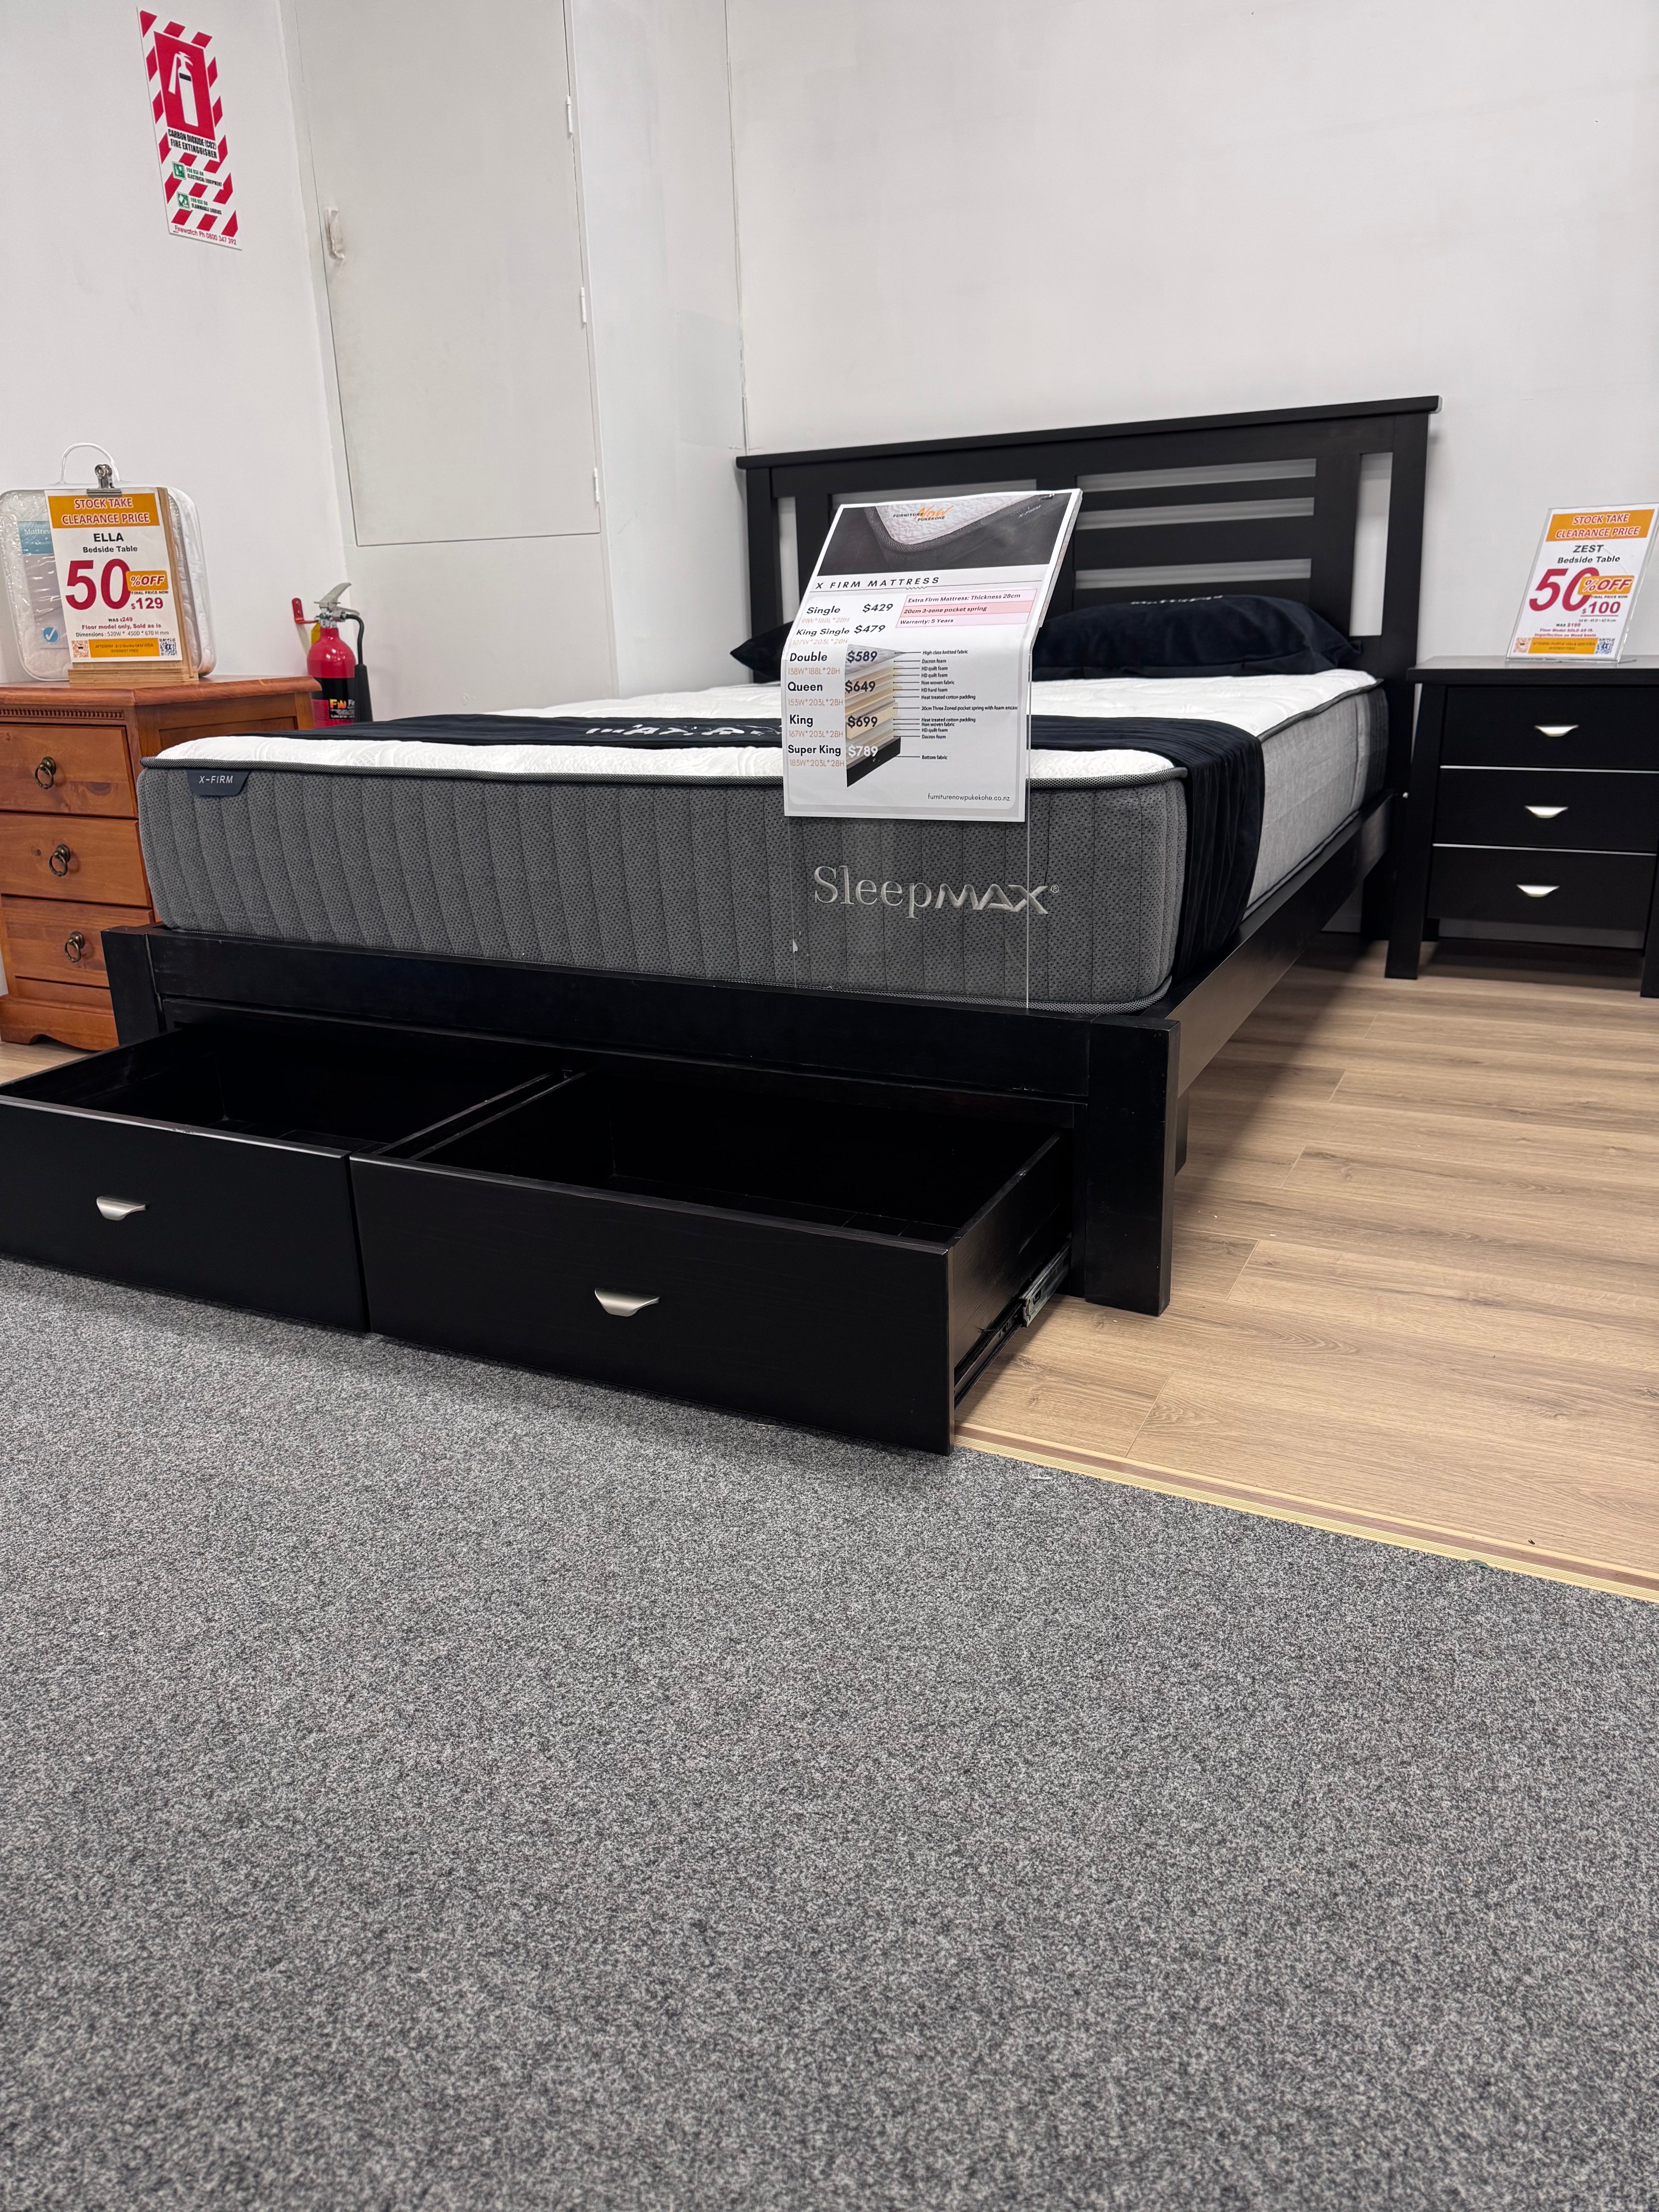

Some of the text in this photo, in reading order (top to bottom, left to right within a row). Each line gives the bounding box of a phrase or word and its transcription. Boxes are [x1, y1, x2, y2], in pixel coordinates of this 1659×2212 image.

[168, 129, 216, 150] CARBON DIOXIDE (CO2)
[170, 139, 217, 158] FIRE EXTINGUISHER
[187, 173, 222, 187] ELECTRICAL EQUIPMENT
[175, 225, 198, 236] Firewatch
[74, 498, 133, 508] STOCK TAKE
[62, 513, 149, 524] CLEARANCE PRICE
[1573, 514, 1629, 525] STOCK TAKE
[93, 532, 124, 542] ELLA
[1556, 527, 1640, 538] CLEARANCE PRICE
[1573, 544, 1604, 553] ZEST
[65, 558, 132, 610] 50
[130, 575, 165, 586] %OFF
[867, 577, 939, 587] MATTRESS
[1583, 579, 1633, 592] %OFF
[1529, 567, 1600, 611] 50
[131, 597, 163, 610] $129
[807, 603, 893, 615] Single $429
[1582, 601, 1621, 614] $100
[820, 628, 850, 636] Single
[854, 625, 886, 634] $479
[790, 650, 878, 663] Double $589
[788, 680, 876, 693] Queen $649
[790, 714, 878, 728] King $699
[788, 744, 878, 758] Super King $789
[199, 775, 233, 783] X-FIRM
[928, 793, 1010, 801] furniturenowpukekohe.co.nz
